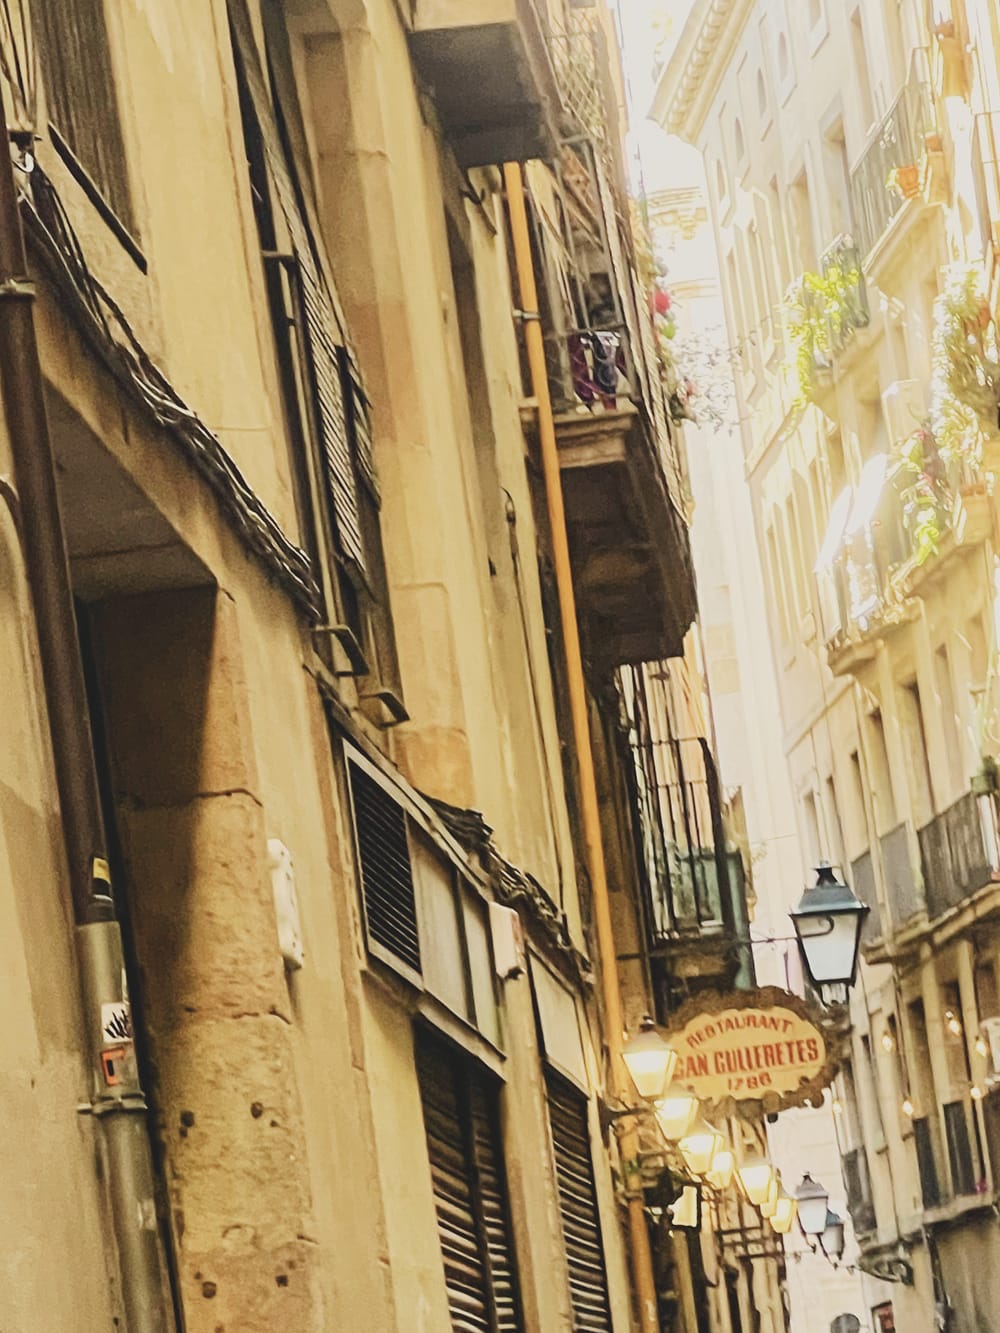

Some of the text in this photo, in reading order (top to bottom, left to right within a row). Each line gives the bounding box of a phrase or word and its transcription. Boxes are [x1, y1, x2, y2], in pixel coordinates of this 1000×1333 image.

[686, 1014, 792, 1049] RESTAURANT
[672, 1038, 818, 1080] CAN CULLERETES
